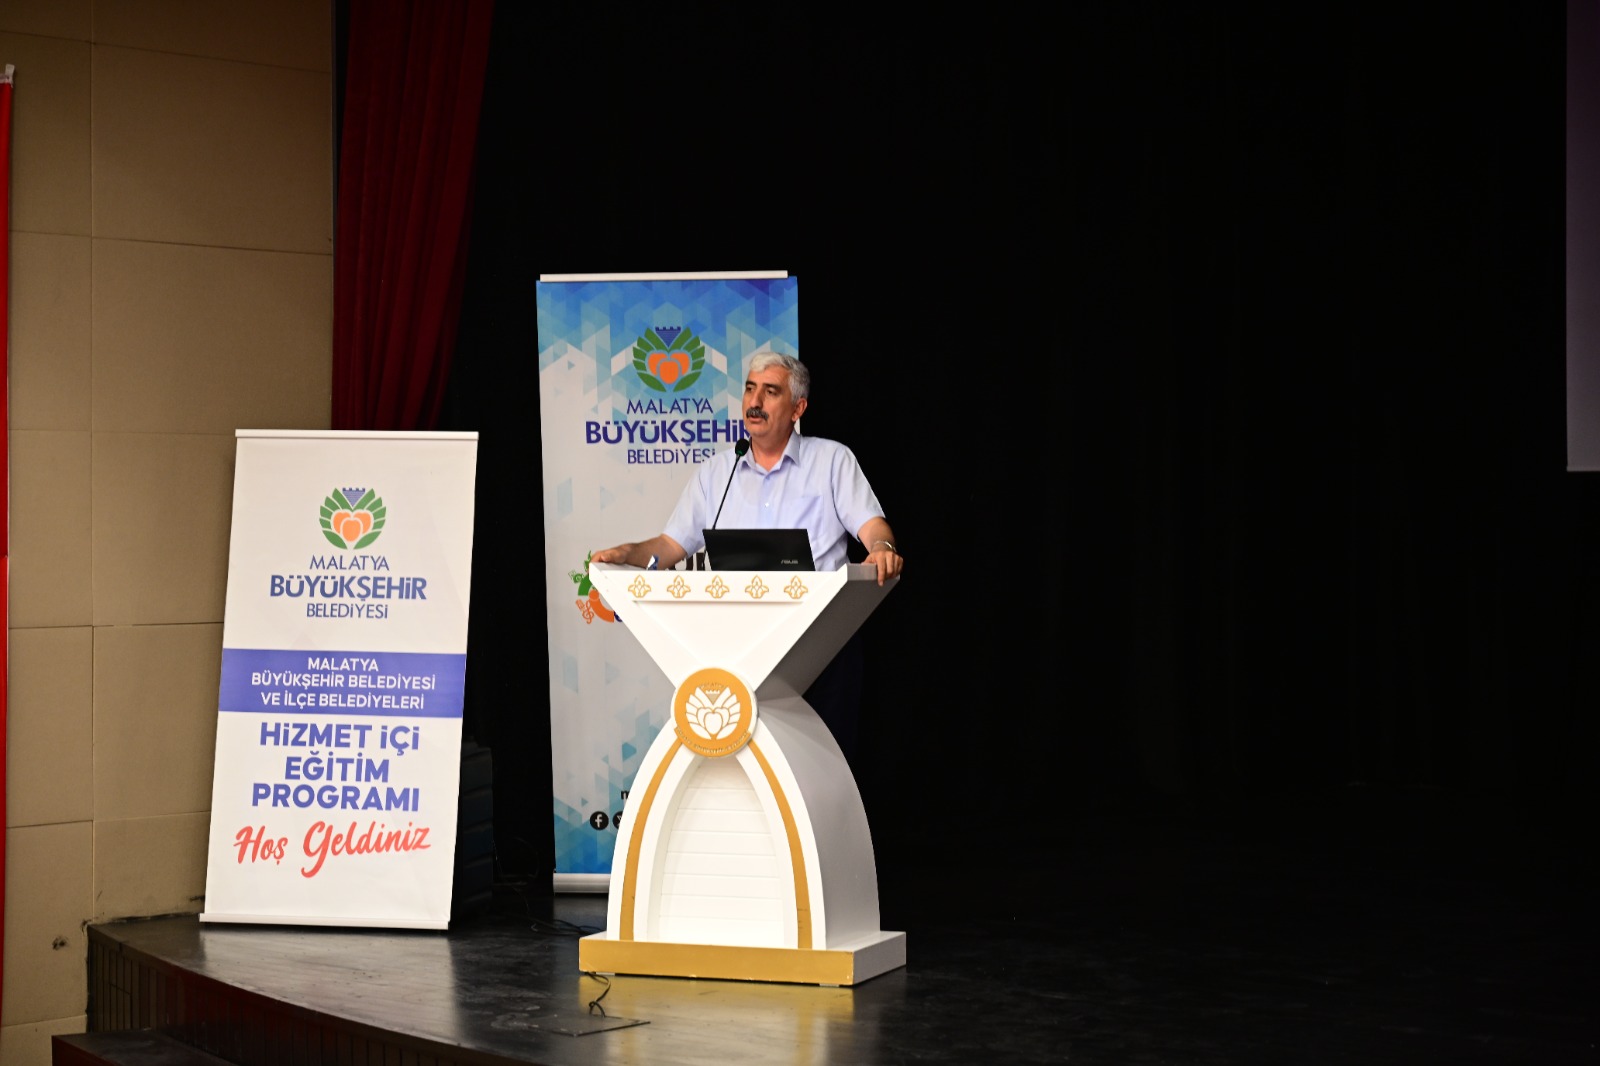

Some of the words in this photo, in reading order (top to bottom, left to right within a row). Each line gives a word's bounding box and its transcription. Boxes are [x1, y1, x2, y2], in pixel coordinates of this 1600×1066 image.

[627, 398, 714, 414] MALATYA
[310, 555, 389, 571] MALATYA
[307, 658, 379, 671] MALATYA
[251, 669, 345, 689] BÜYÜKŞEHİR
[349, 673, 436, 690] BELEDİYESİ
[261, 692, 280, 706] VE
[284, 690, 316, 710] İLÇE
[319, 692, 425, 709] BELEDİYELERİ
[284, 751, 390, 783] EĞİTİM
[252, 783, 420, 812] PROGRAMI
[234, 825, 288, 865] Hoş
[301, 821, 431, 878] Geldiniz
